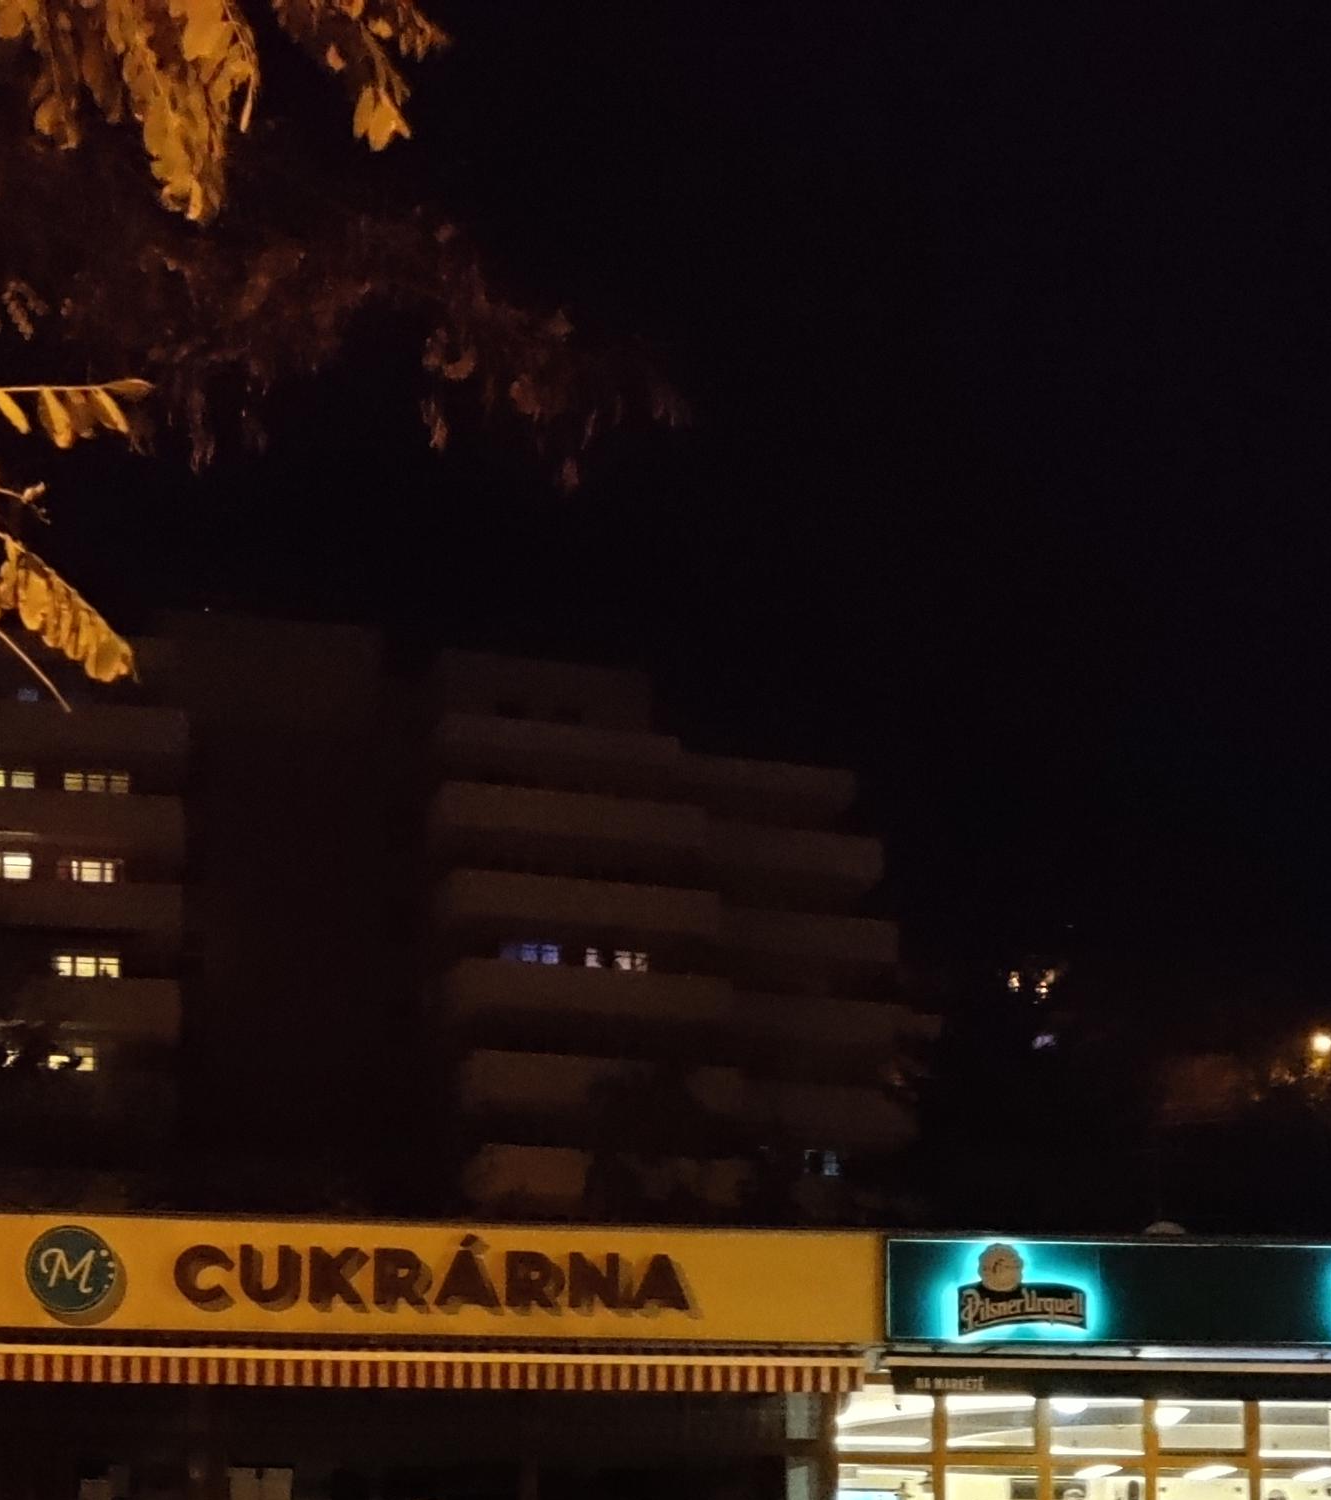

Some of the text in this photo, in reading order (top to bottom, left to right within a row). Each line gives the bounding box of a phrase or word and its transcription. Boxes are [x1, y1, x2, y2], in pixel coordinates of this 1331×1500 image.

[174, 1233, 692, 1312] CUKRÁRNA
[960, 1287, 1084, 1332] Pilsner Urquell
